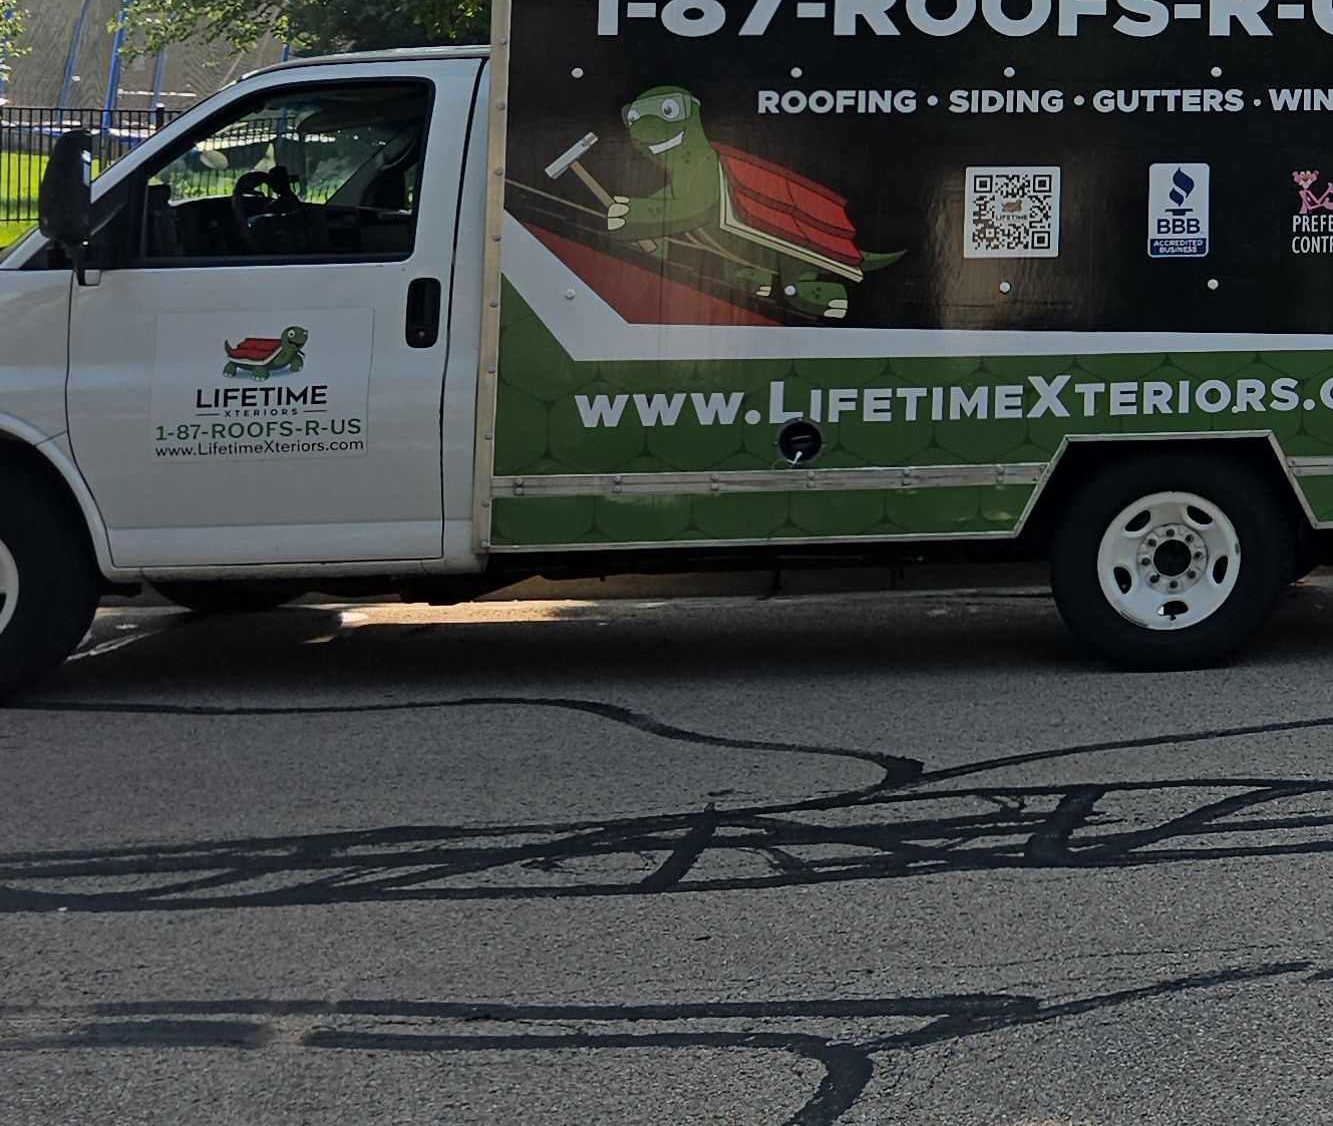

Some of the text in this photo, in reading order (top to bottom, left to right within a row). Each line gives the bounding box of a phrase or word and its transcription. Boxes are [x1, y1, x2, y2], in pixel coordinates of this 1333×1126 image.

[757, 89, 917, 114] ROOFING
[948, 88, 1064, 114] SIDING
[1092, 88, 1244, 113] GUTTERS
[1157, 218, 1200, 234] BBB
[1153, 239, 1203, 247] ACCREDITED
[196, 385, 328, 408] LIFETIME
[224, 407, 298, 418] XTERIORS
[155, 418, 362, 441] 1-87-ROOFS-R-US
[155, 439, 364, 457] www.LifetimeXteriors.com
